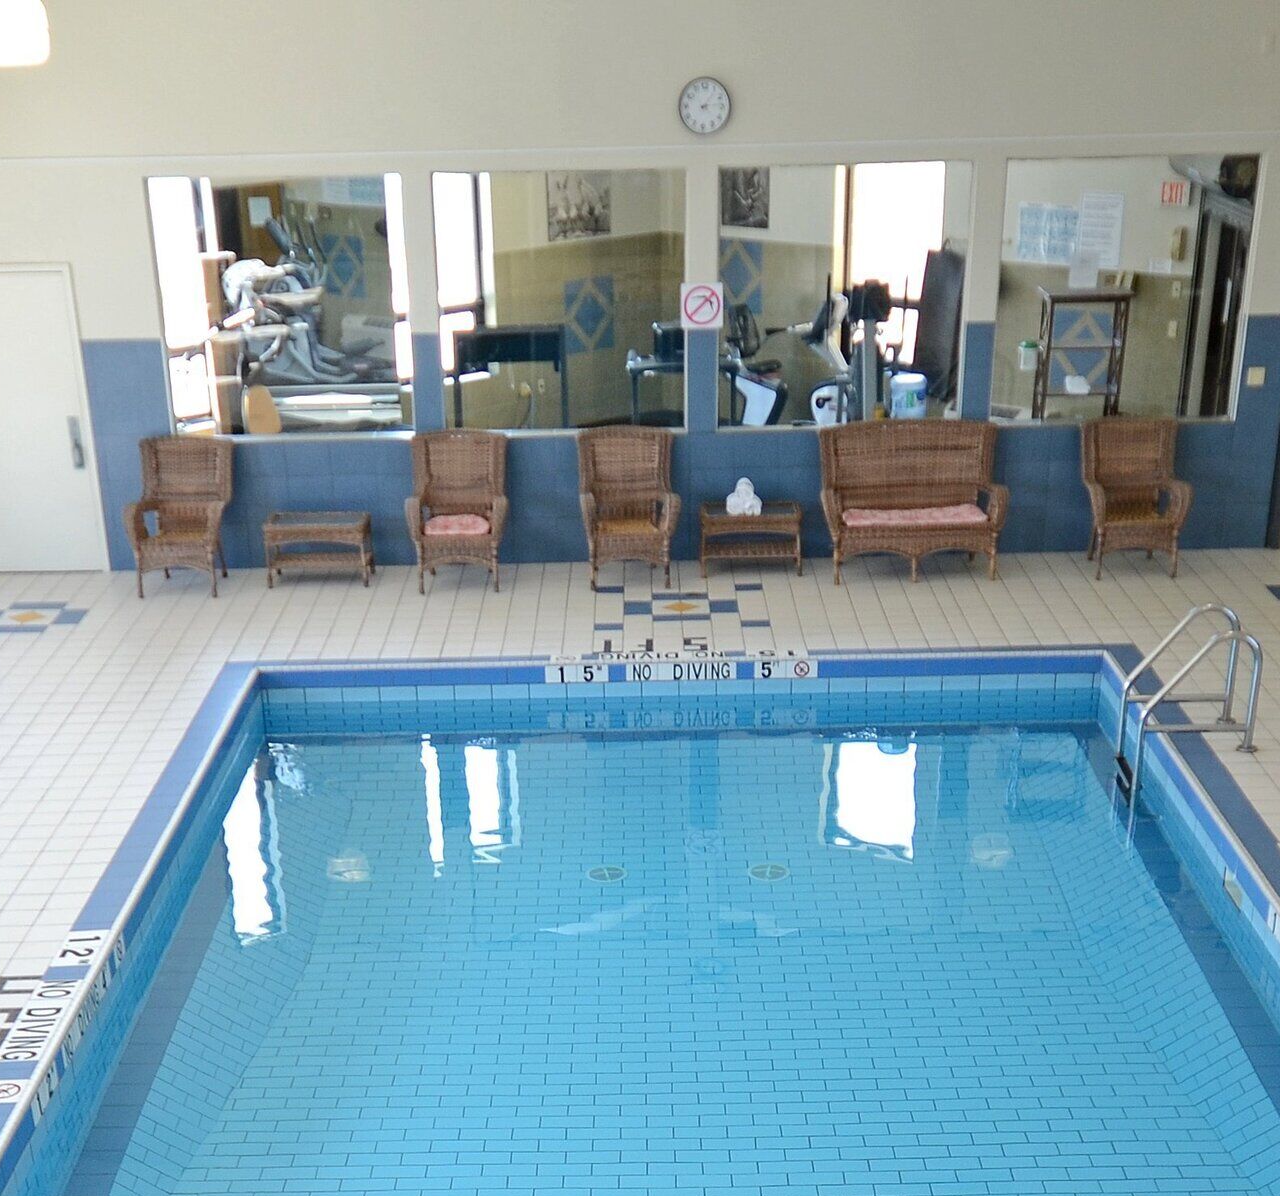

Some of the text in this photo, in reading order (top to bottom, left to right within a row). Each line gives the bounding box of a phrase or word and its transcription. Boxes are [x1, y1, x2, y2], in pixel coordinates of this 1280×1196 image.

[1161, 181, 1185, 204] EXIT
[633, 664, 652, 680] NO
[673, 662, 730, 680] DIVING
[2, 979, 78, 1060] NO DIVING
